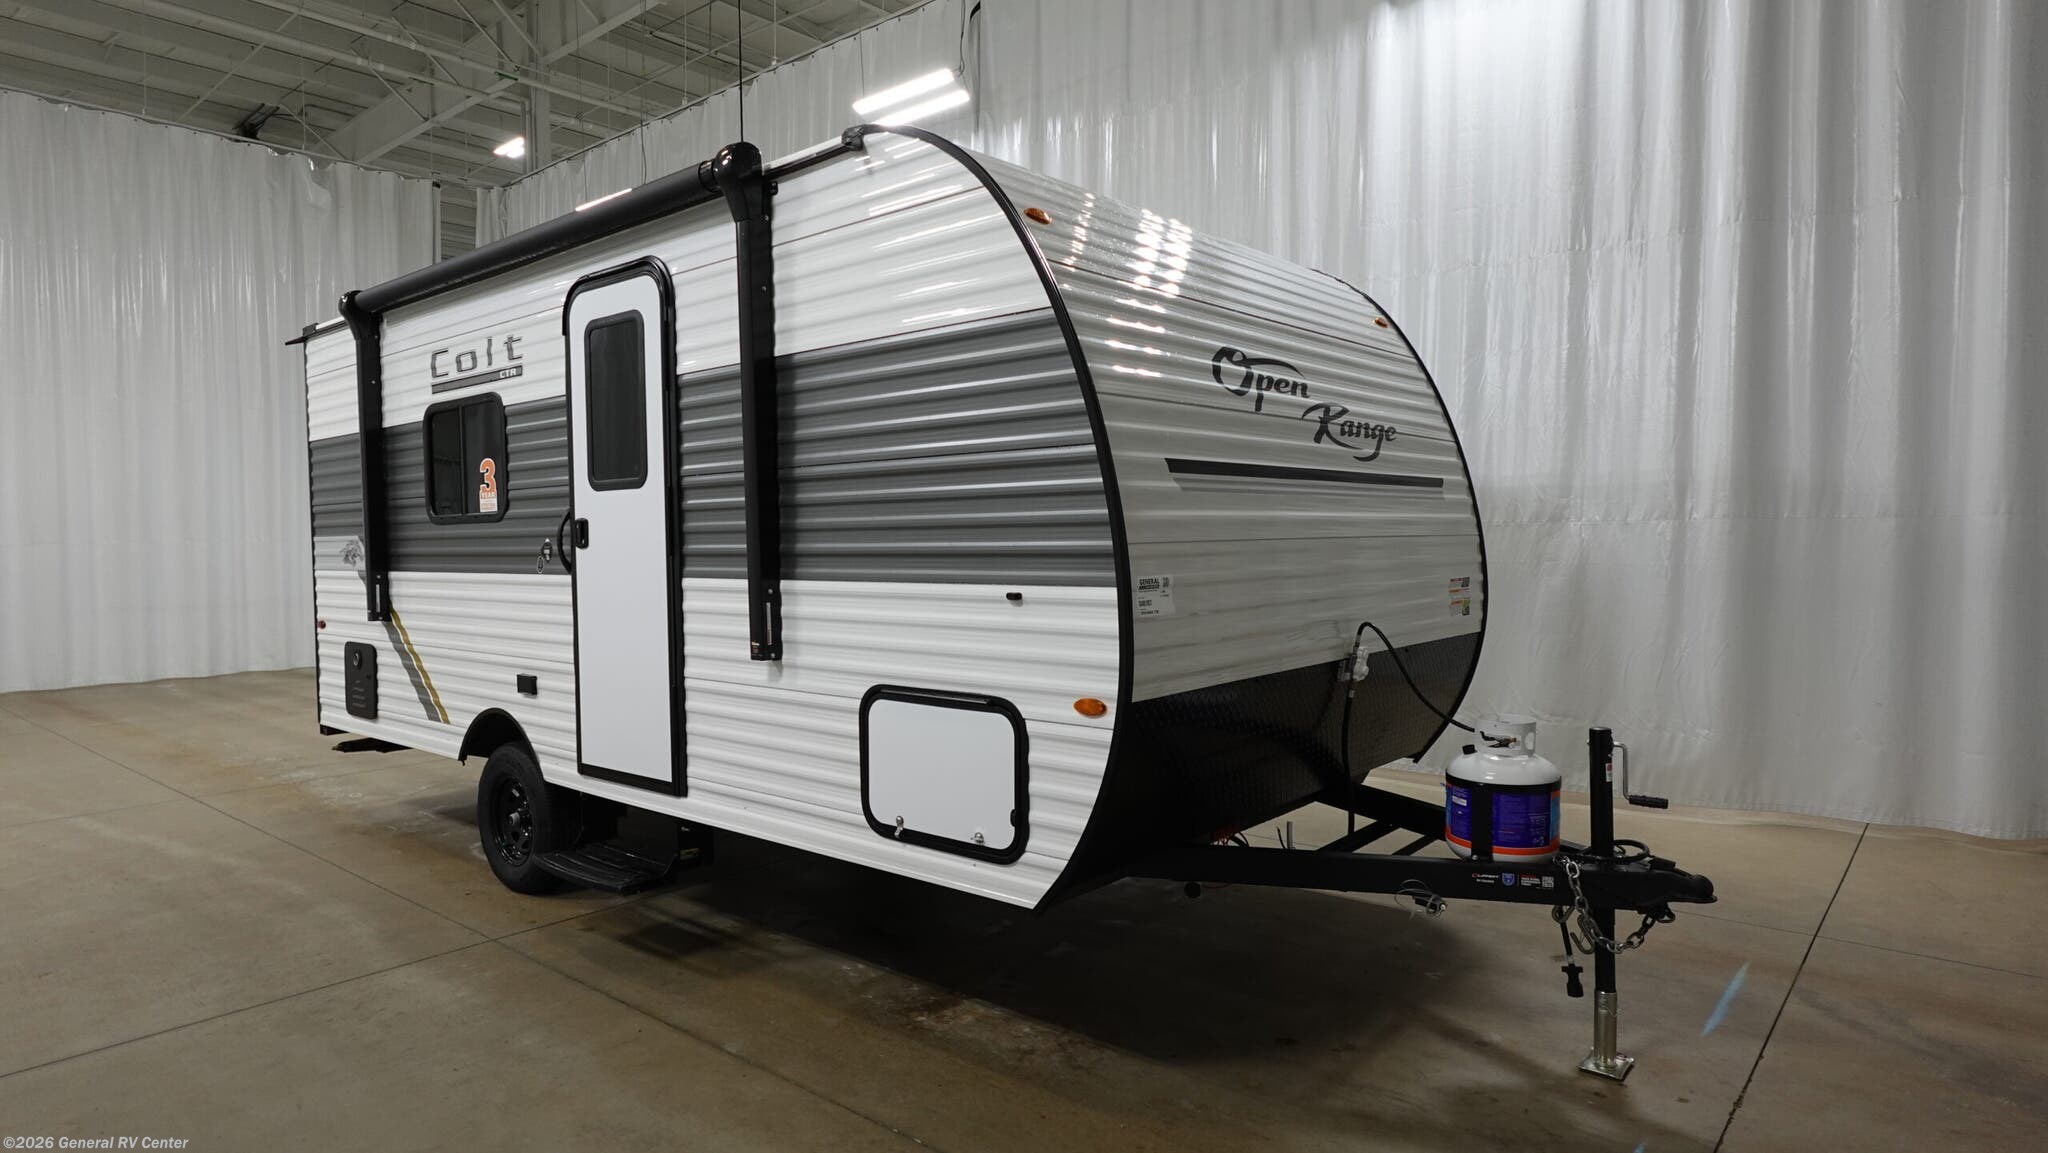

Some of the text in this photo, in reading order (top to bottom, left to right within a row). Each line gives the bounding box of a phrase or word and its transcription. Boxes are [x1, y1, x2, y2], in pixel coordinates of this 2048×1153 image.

[431, 336, 523, 378] Colt
[500, 367, 517, 379] CTR
[1212, 346, 1310, 412] Open
[1302, 402, 1397, 462] Range
[480, 458, 496, 493] 3
